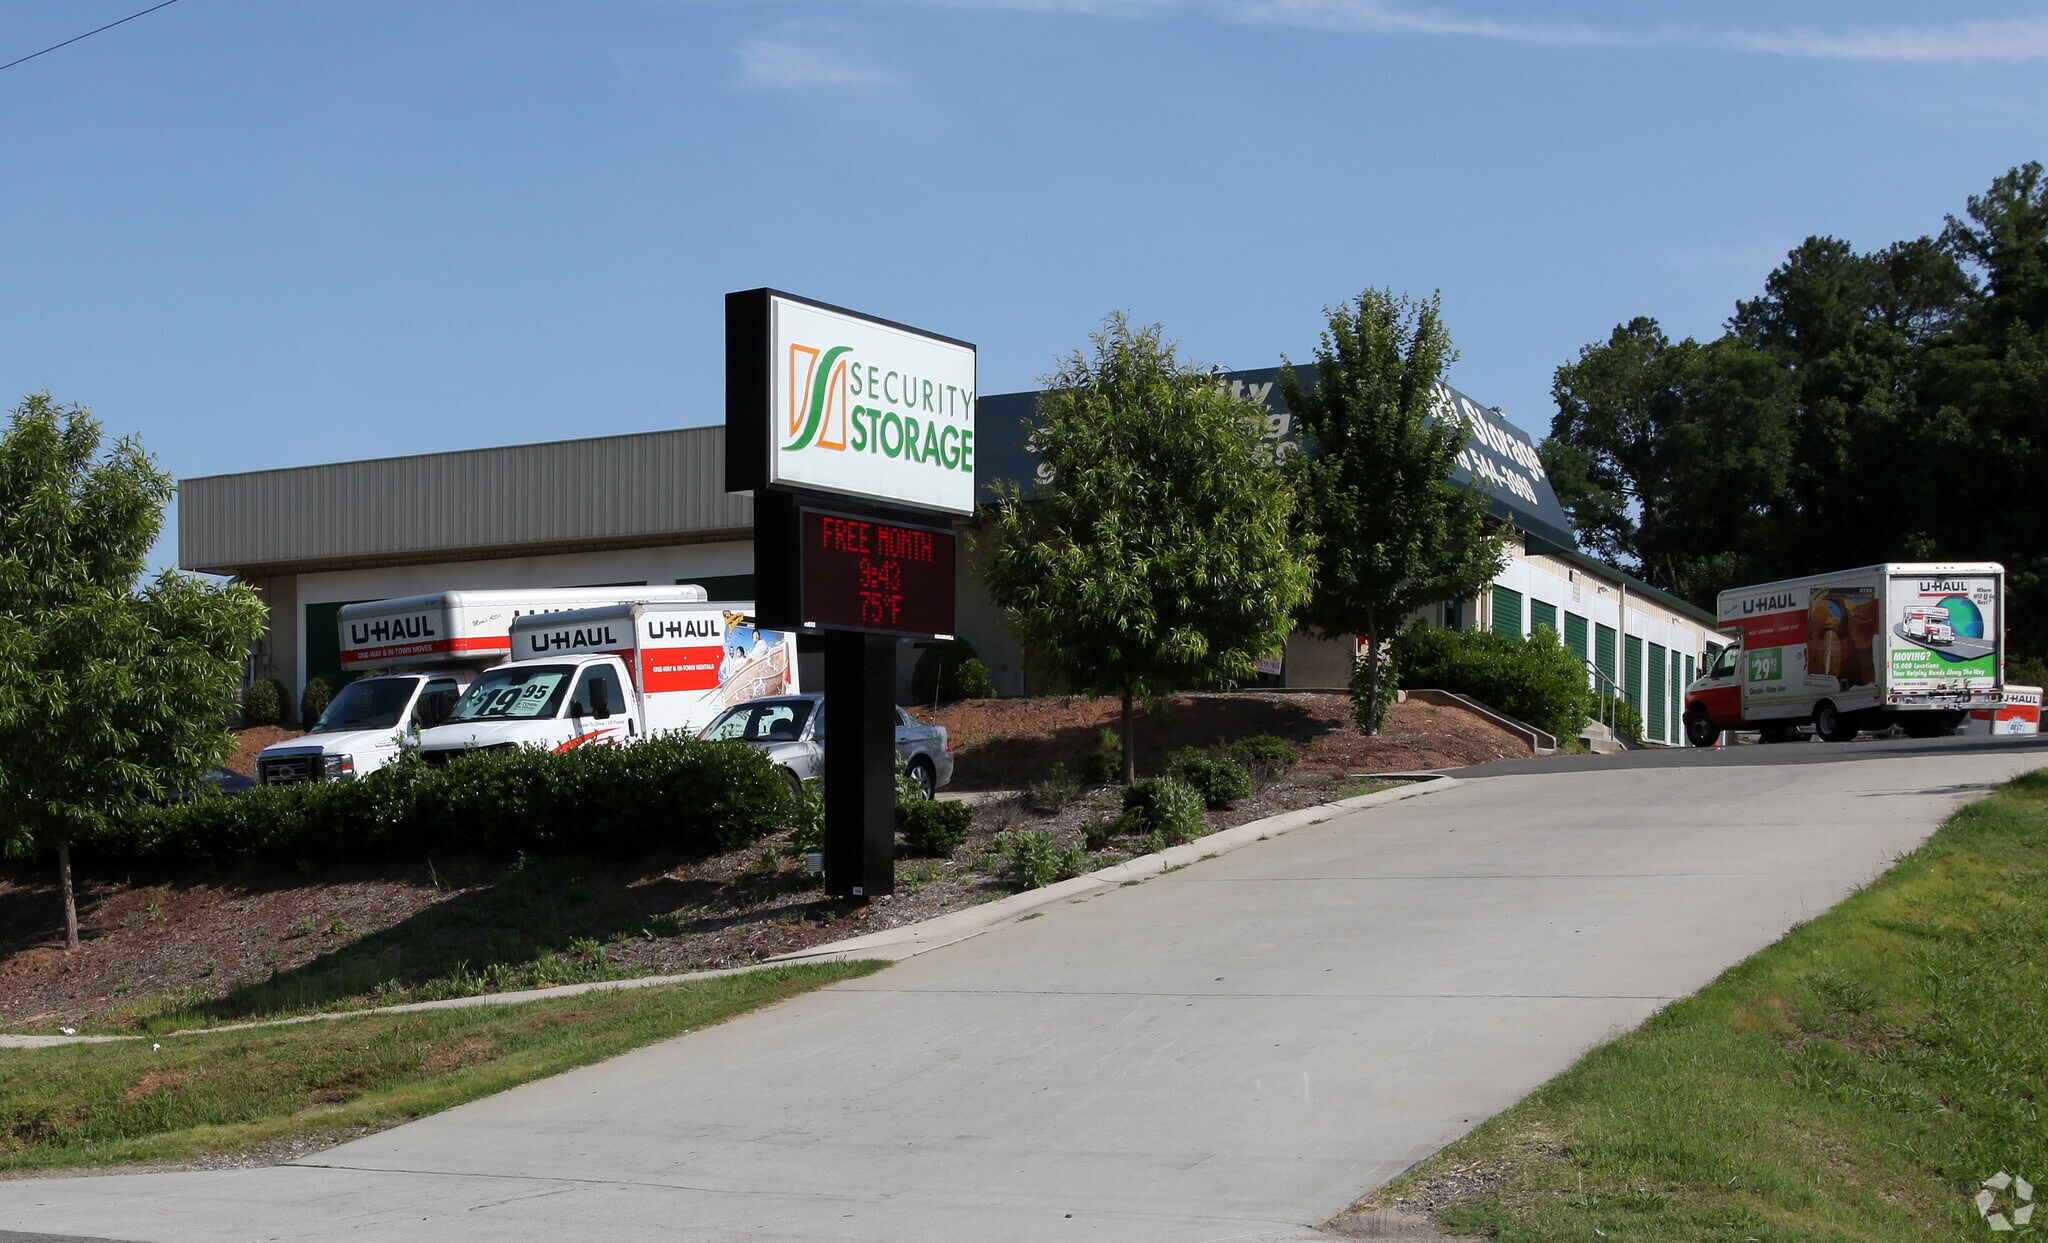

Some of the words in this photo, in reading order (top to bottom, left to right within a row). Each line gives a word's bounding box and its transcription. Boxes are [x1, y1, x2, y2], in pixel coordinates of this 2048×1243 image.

[851, 361, 973, 421] SECURITY
[851, 405, 973, 472] STORAGE
[1461, 397, 1545, 481] Storage
[1469, 448, 1538, 505] 544-3969
[823, 517, 870, 554] FREE
[878, 526, 932, 562] MONTH
[859, 557, 901, 591] 9:43
[1920, 581, 1968, 592] U-HAUL
[1743, 593, 1796, 614] U-HAUL
[351, 616, 435, 645] U-HAUL
[531, 626, 618, 652] U-HAUL
[649, 620, 720, 639] U-HAUL
[357, 651, 383, 659] ONE-WAY
[388, 647, 412, 656] IN-TOWN
[412, 644, 433, 653] MOVES
[1893, 651, 1931, 661] MOVING?
[522, 684, 550, 699] 95
